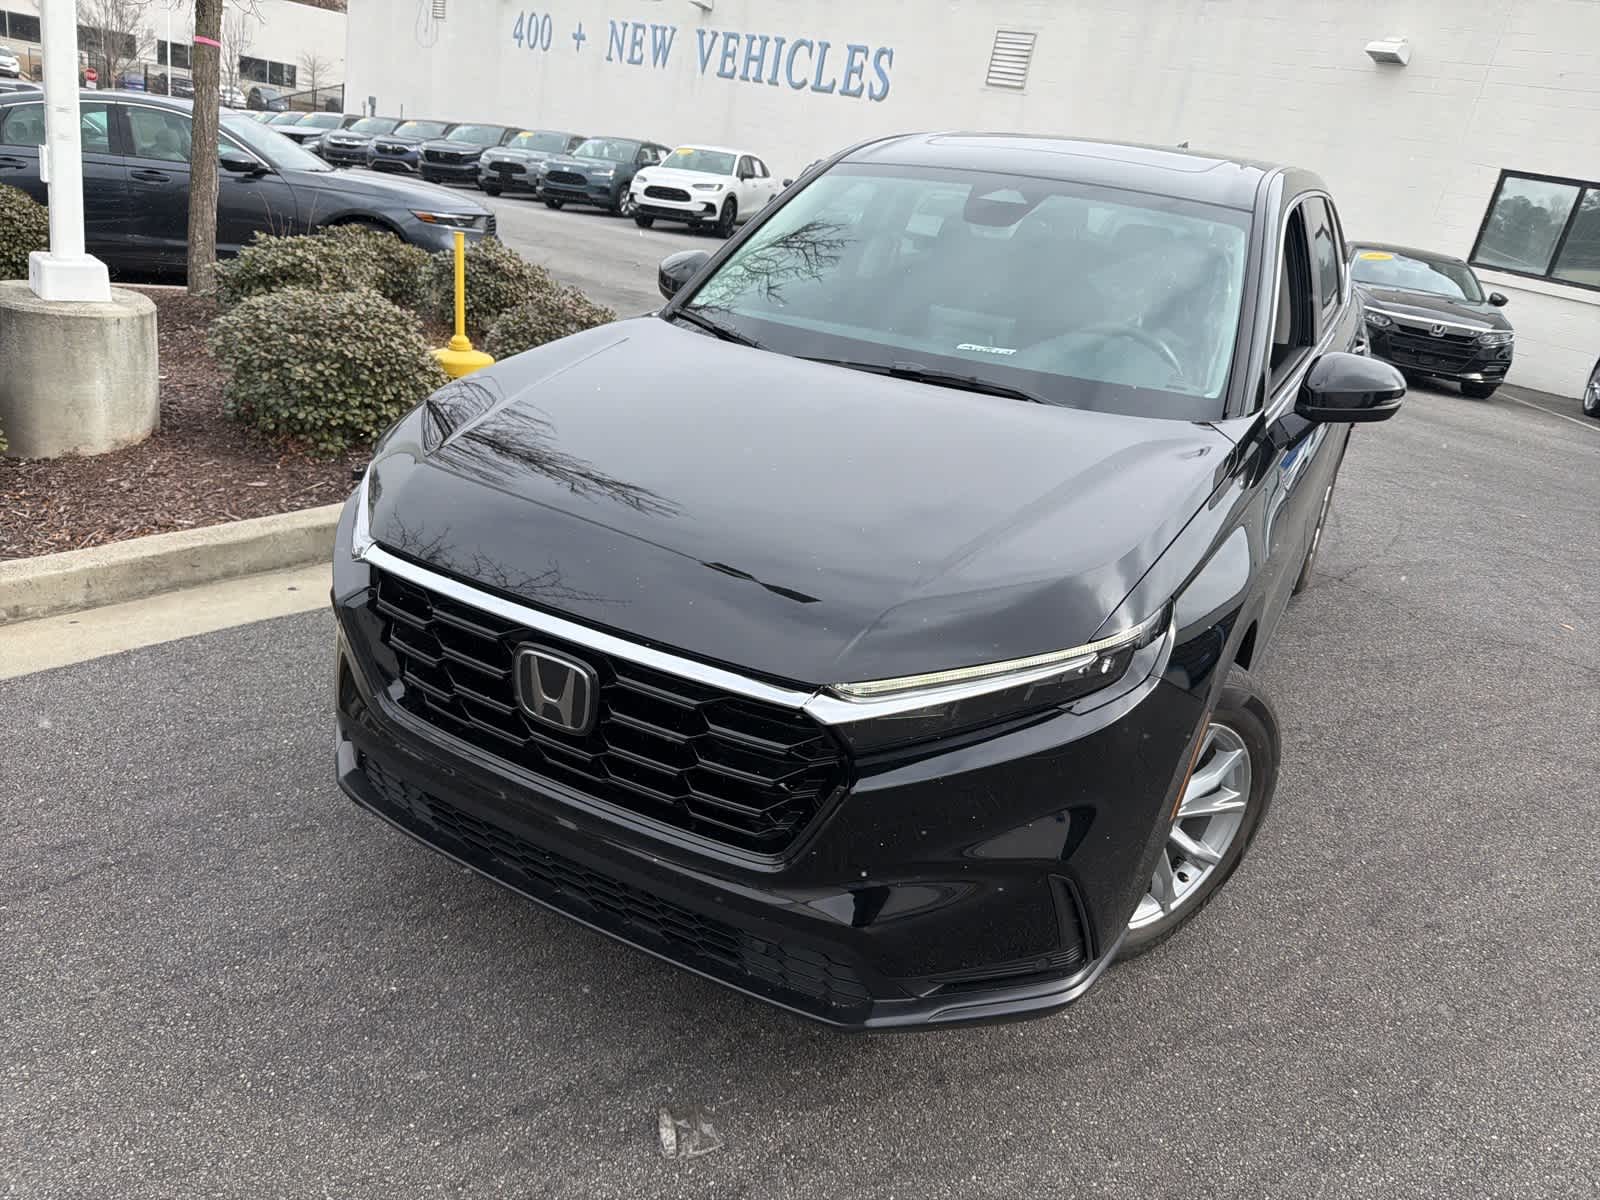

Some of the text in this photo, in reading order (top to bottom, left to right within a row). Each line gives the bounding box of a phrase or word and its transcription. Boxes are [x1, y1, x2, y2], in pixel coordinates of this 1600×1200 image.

[512, 11, 894, 102] 400 + NEW VEHICLES
